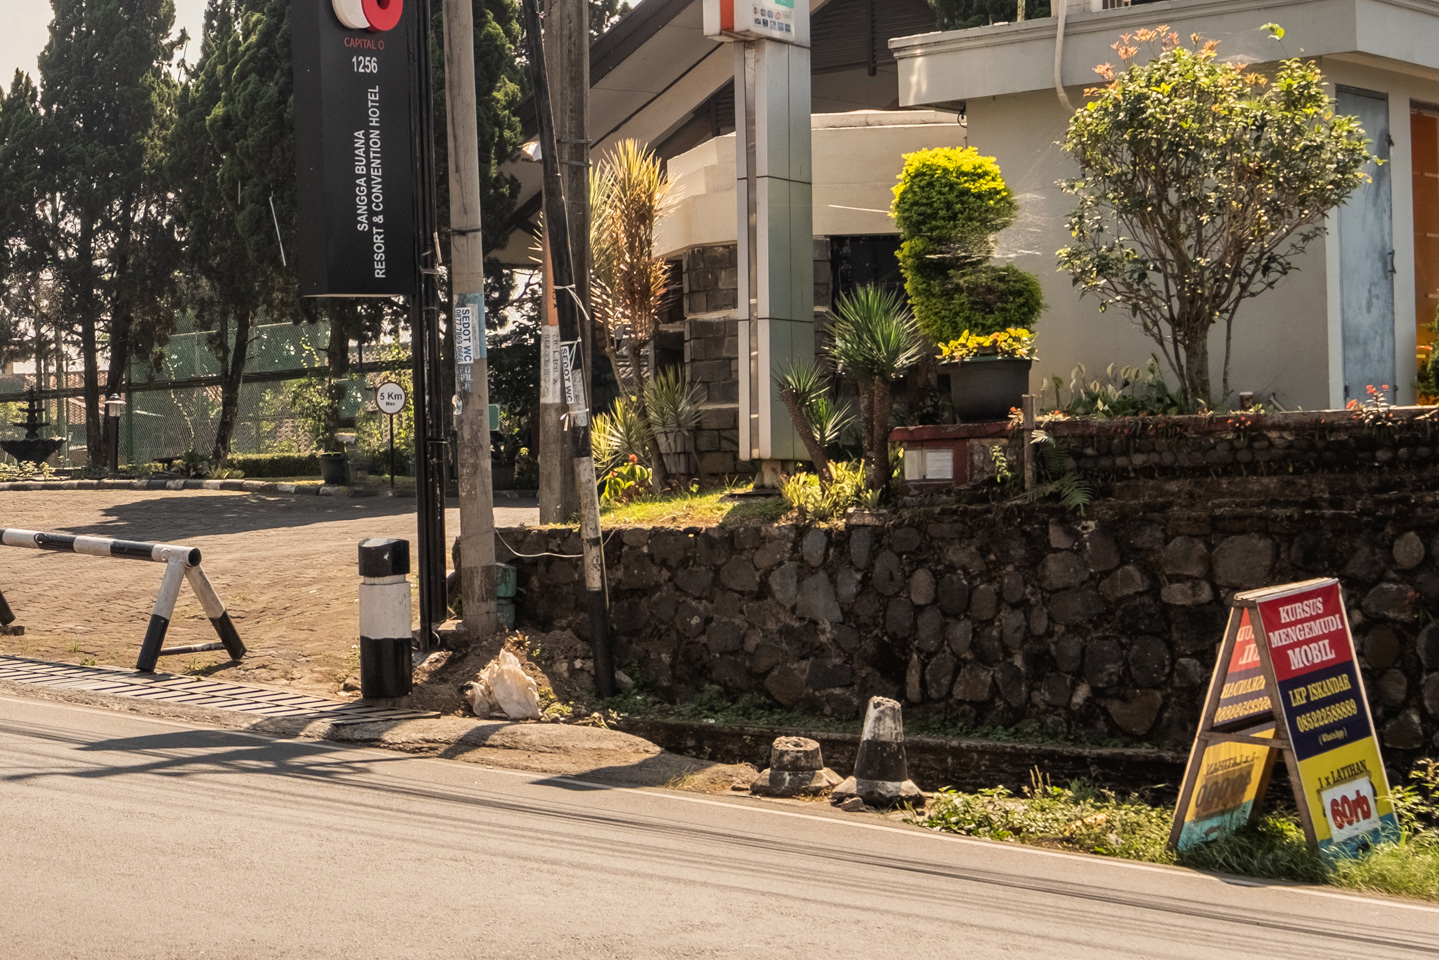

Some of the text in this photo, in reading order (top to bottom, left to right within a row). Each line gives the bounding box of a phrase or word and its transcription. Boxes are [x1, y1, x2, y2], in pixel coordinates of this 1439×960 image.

[344, 37, 377, 50] CAPITAL
[352, 55, 378, 73] 1256
[354, 130, 369, 232] SANGGA BUANA
[368, 85, 386, 278] RESORT & CONVENTION HOTEL
[462, 309, 471, 343] SEDOT
[463, 346, 472, 362] WC
[380, 392, 403, 400] 5 Km
[565, 385, 573, 402] WC
[1279, 597, 1324, 624] KURSUS
[1268, 614, 1343, 648] MENGEMUDI
[1287, 639, 1336, 670] MOBIL
[1288, 673, 1352, 707] LKP ISKANDAR
[1330, 759, 1368, 784] LATIHAN
[1330, 789, 1372, 830] 60rb
